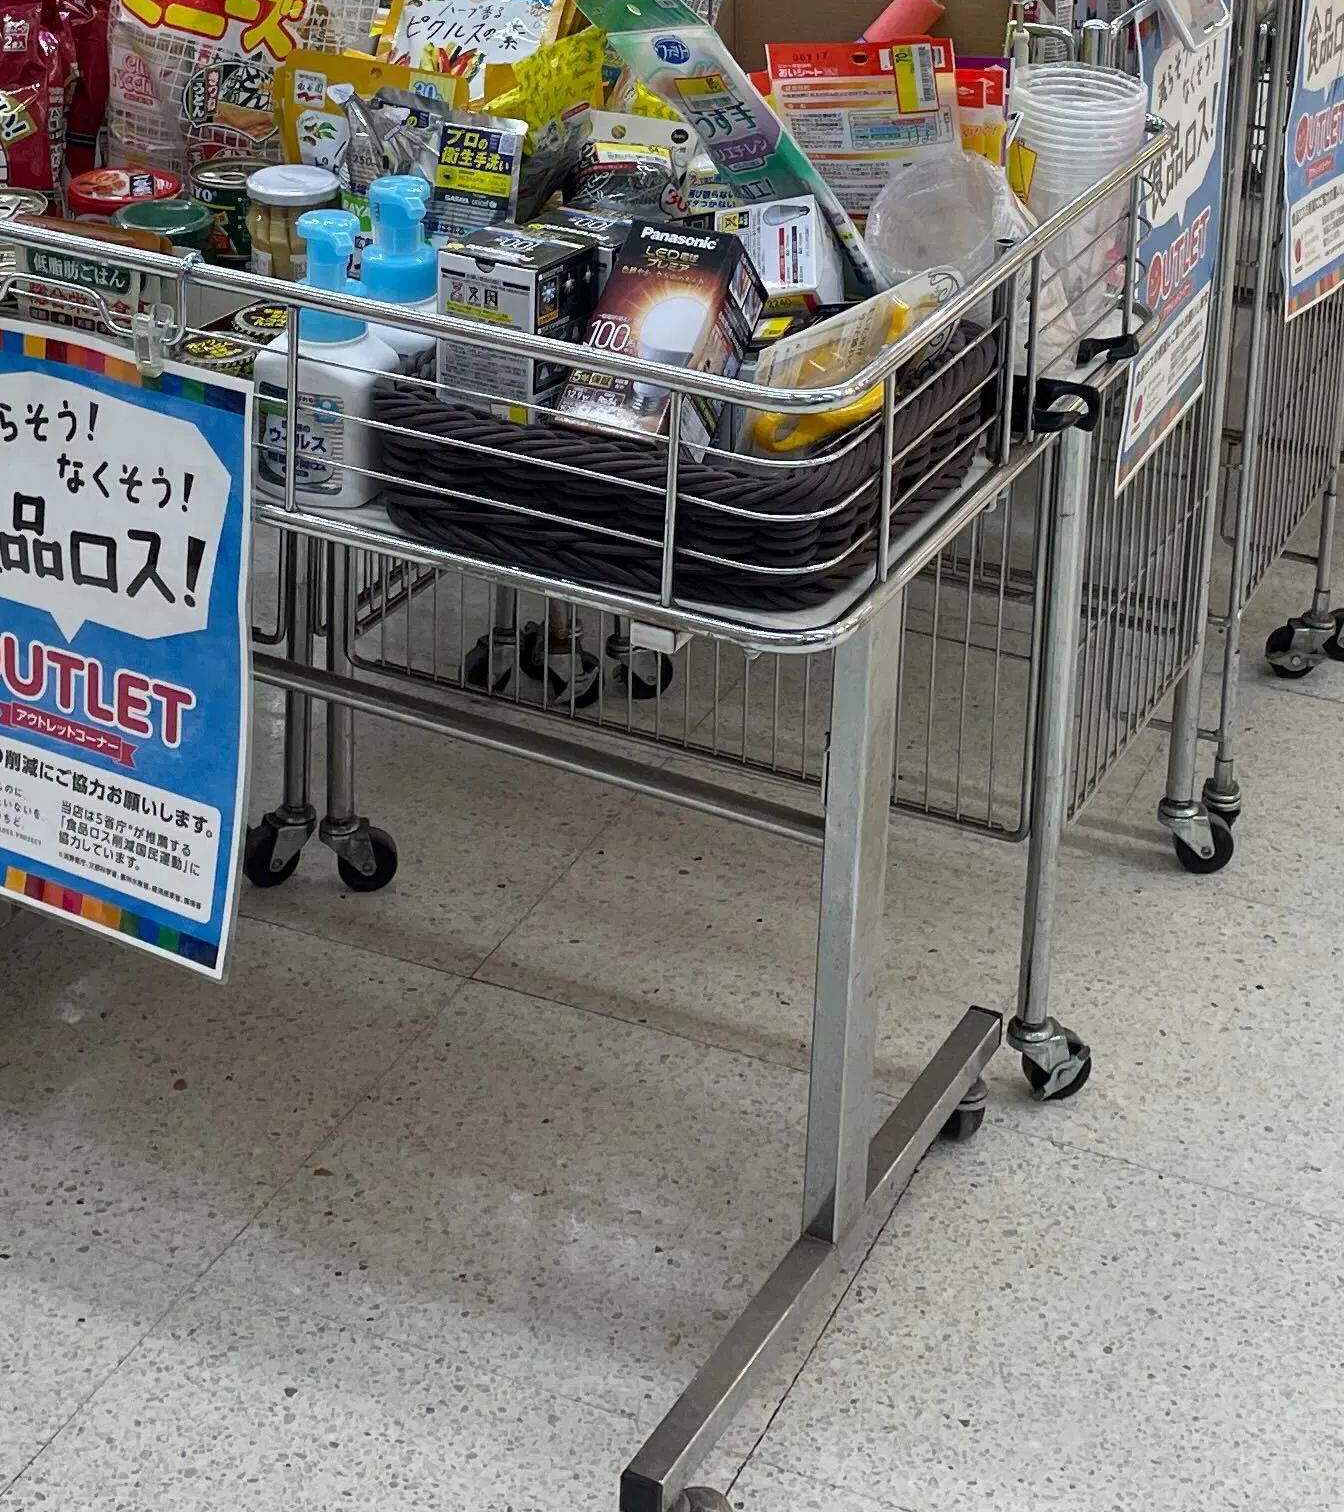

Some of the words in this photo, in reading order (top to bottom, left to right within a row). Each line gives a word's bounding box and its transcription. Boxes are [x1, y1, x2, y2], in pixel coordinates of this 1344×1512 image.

[439, 3, 505, 19] ハーブ香る
[694, 102, 758, 138] うす手
[446, 128, 489, 149] プロの
[440, 145, 510, 173] 衛生手洗い
[640, 226, 718, 251] Panasonic
[645, 244, 701, 264] LED電球
[33, 251, 126, 290] 低脂肪ごはん
[646, 258, 691, 272] プレミア
[1146, 206, 1212, 307] OUTLET
[588, 320, 631, 351] 100
[571, 370, 613, 388] 5年保証
[56, 453, 193, 512] なくそう!
[15, 707, 120, 752] アウトレットコーナー
[58, 831, 141, 871] 協力しています。
[59, 817, 201, 877] 「食品ロス削減国民運動」に
